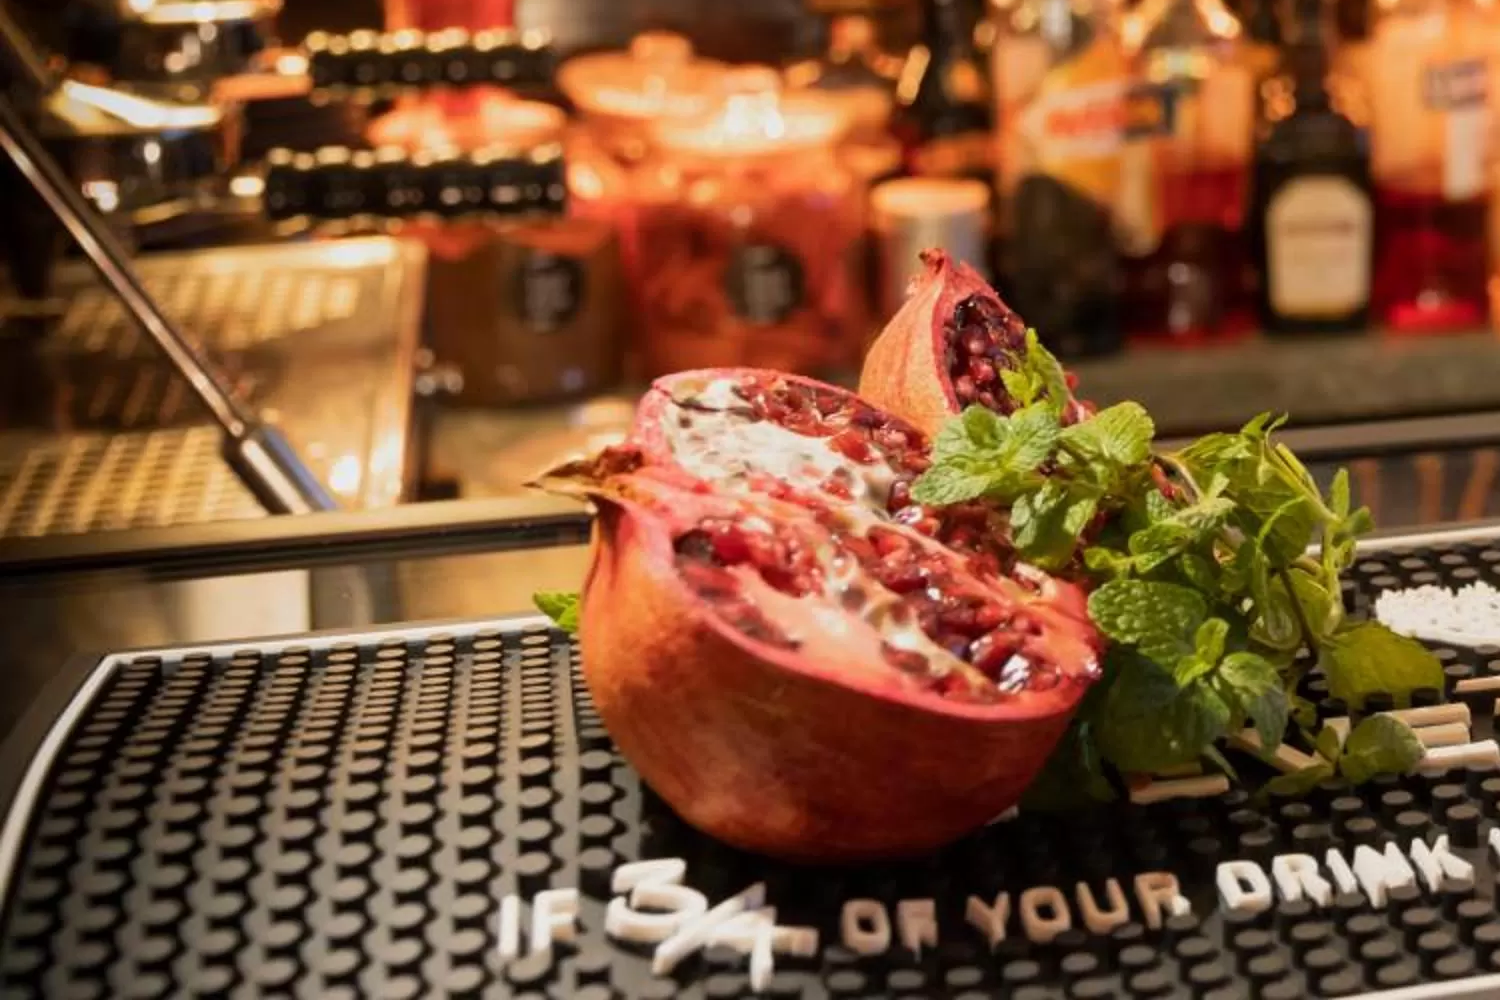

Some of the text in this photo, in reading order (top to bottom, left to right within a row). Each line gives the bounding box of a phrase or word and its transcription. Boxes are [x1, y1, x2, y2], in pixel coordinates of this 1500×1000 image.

[499, 887, 580, 960] IF
[840, 897, 938, 961] OF
[966, 870, 1191, 949] YOUR
[1216, 833, 1475, 912] DRINK
